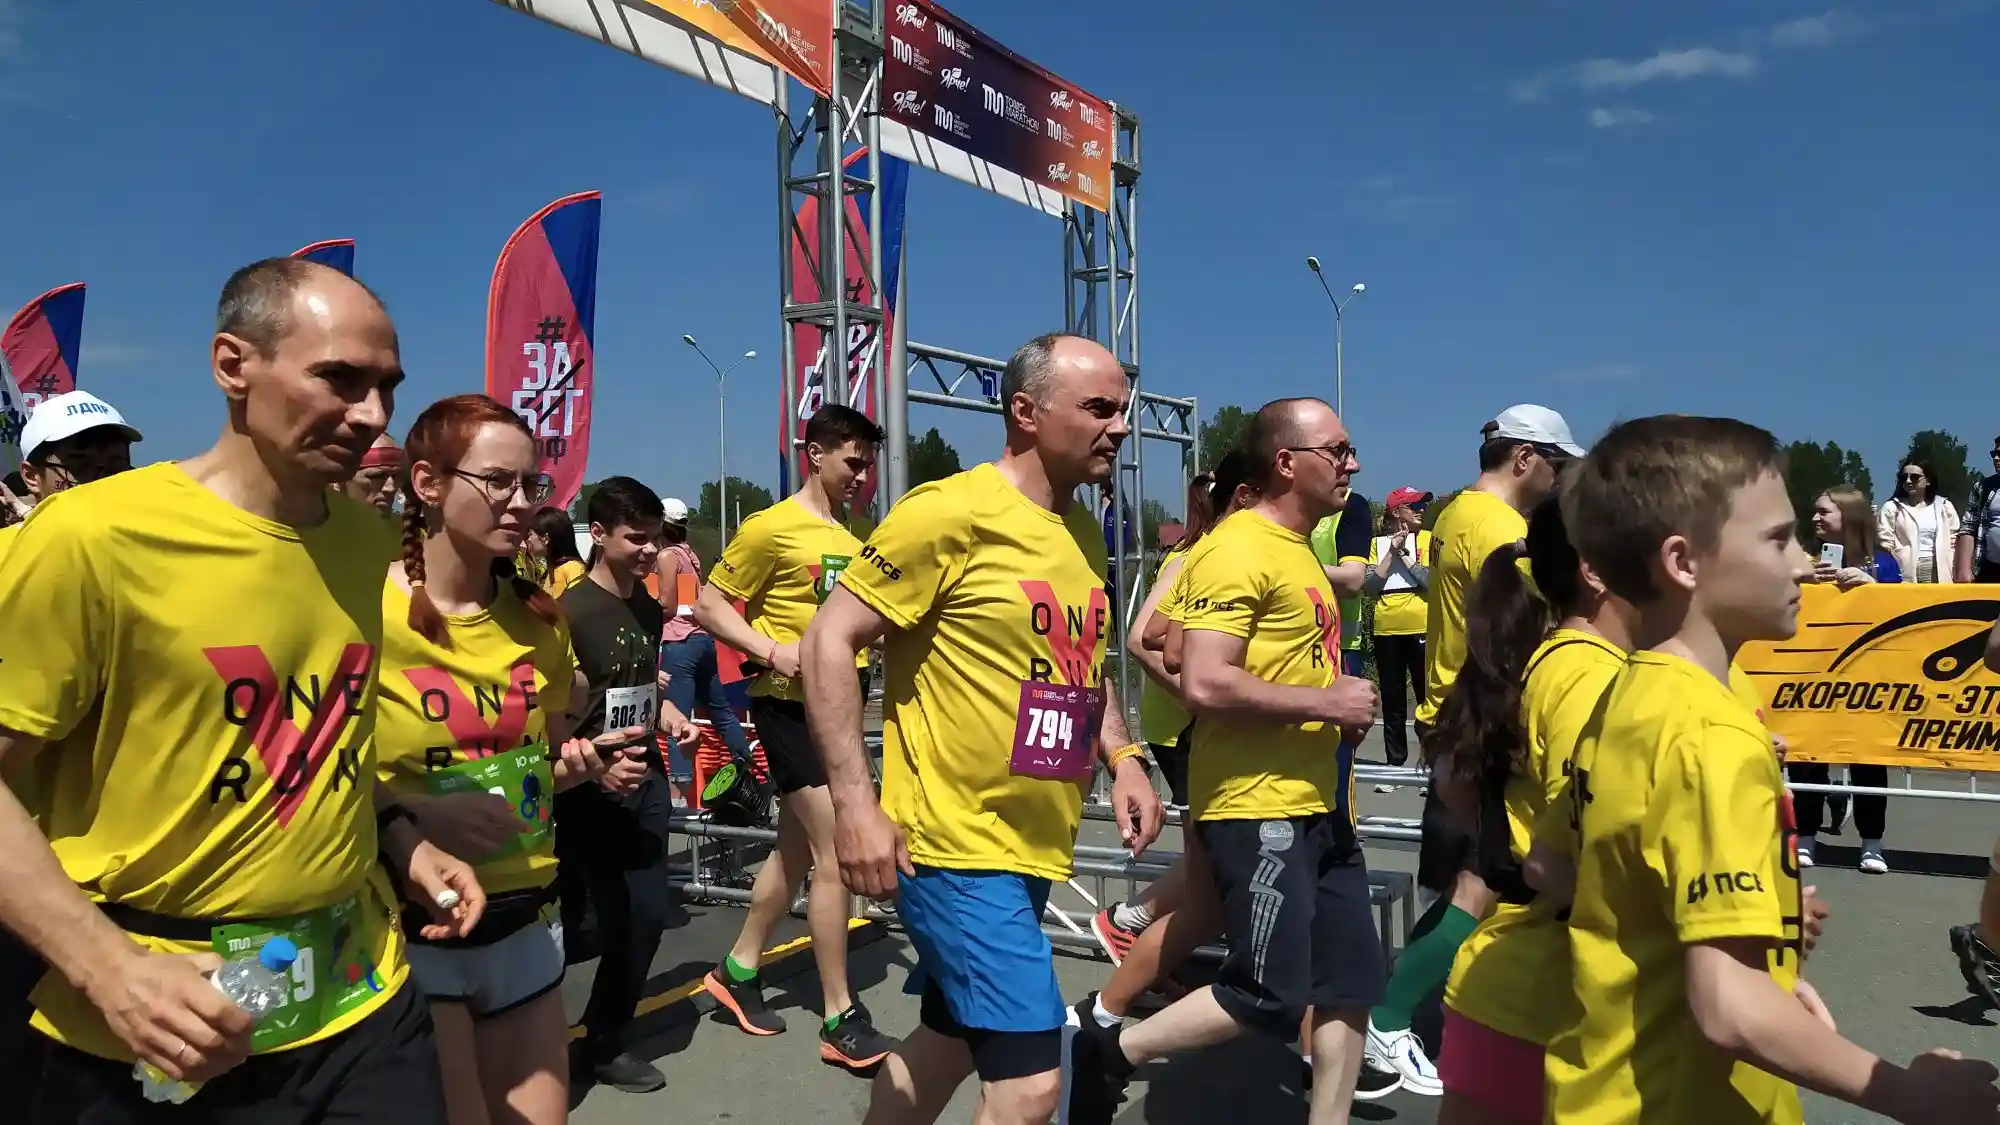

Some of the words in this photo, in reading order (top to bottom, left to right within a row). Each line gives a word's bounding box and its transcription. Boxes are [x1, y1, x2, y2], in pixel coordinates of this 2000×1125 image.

[896, 4, 927, 31] Ярче!
[941, 68, 970, 92] Ярче!
[892, 90, 926, 116] Ярче!
[1031, 602, 1104, 640] ONE
[224, 673, 367, 727] ONE
[420, 679, 541, 723] ONE
[1771, 681, 1926, 713] СКОРОСТЬ
[1954, 685, 2000, 715] ЭТ
[610, 704, 637, 729] 302
[1025, 707, 1073, 750] 794
[210, 747, 362, 804] RUN
